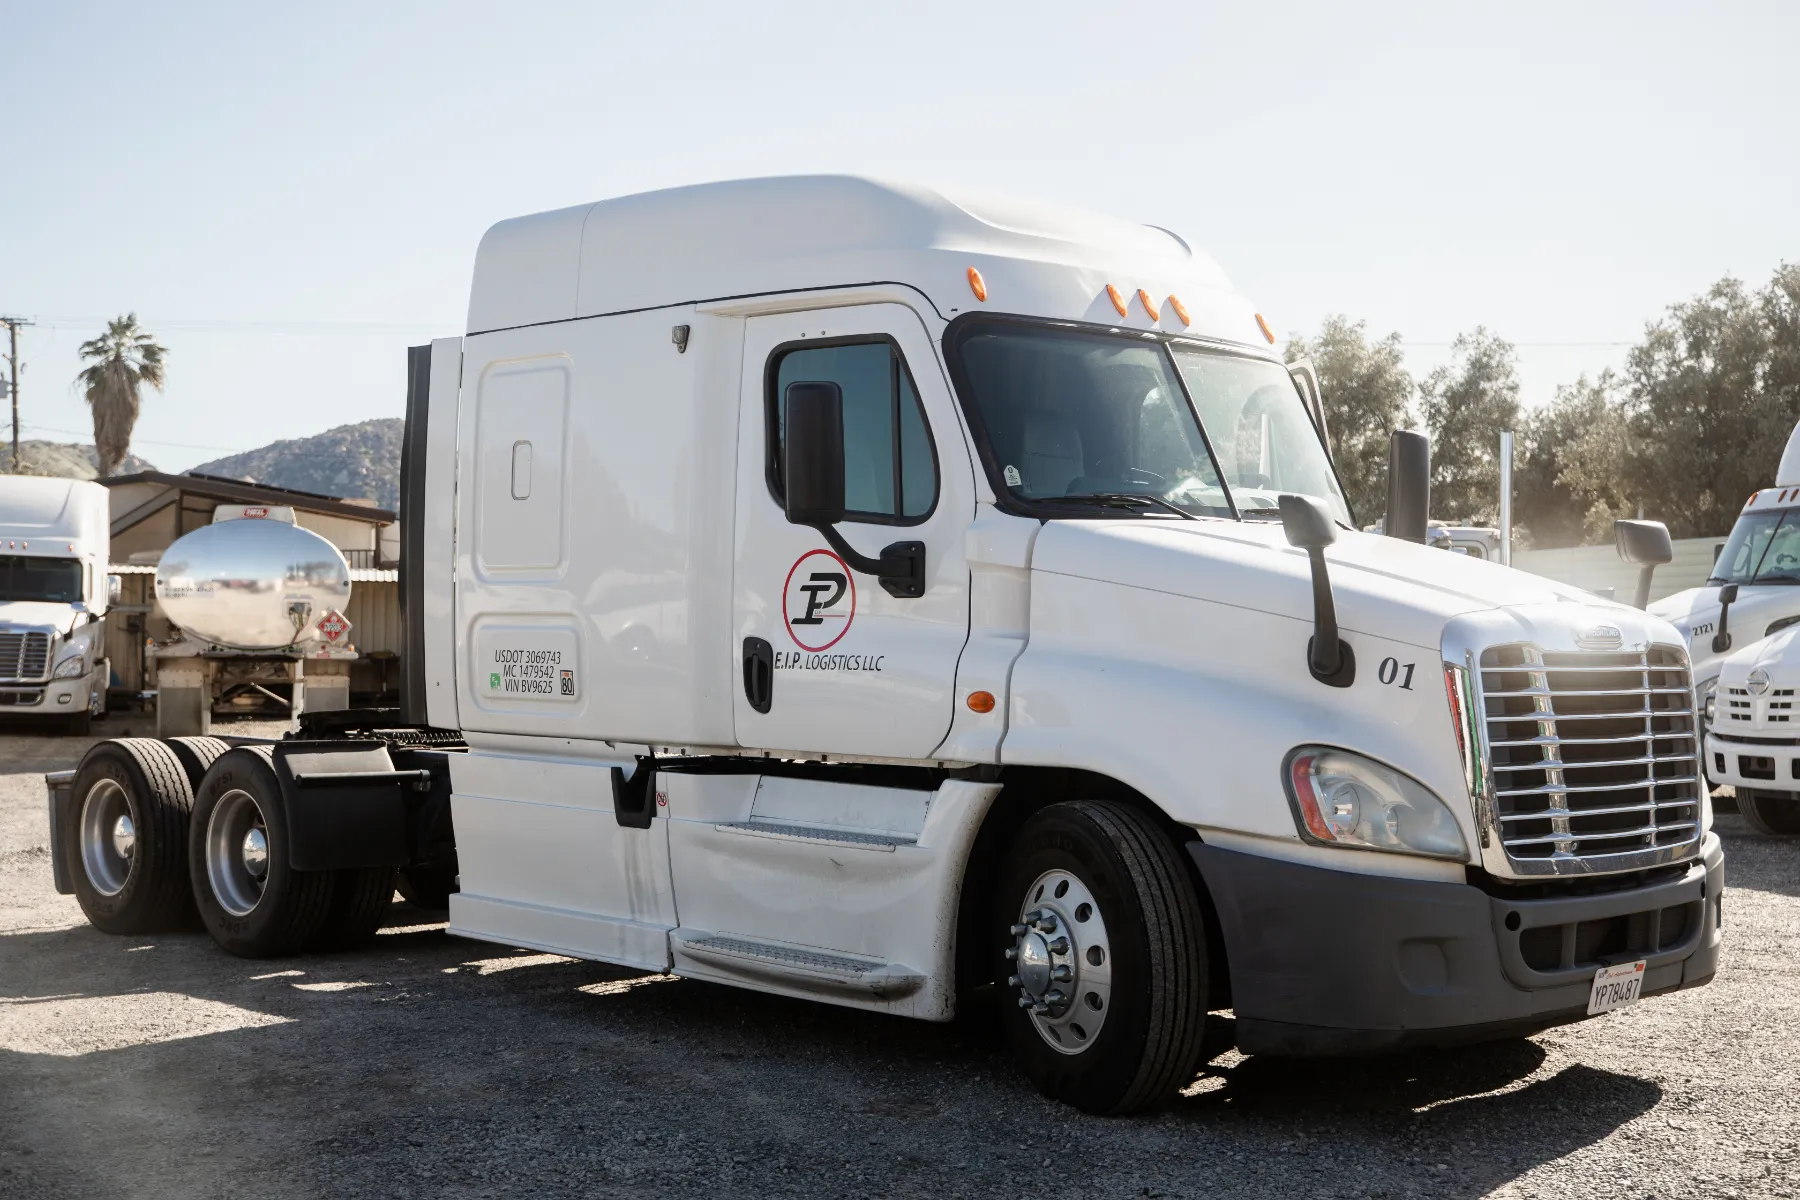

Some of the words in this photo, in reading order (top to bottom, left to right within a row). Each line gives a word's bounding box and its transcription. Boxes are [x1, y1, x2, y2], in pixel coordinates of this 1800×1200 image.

[495, 650, 524, 663] USDOT
[525, 650, 561, 664] 3069743
[774, 652, 803, 670] E.I.P.
[805, 654, 860, 670] LOGISTICS
[862, 655, 885, 671] LLC
[503, 664, 517, 678] MC
[519, 664, 555, 679] 1479542
[1378, 656, 1416, 691] 01
[504, 678, 519, 692] VIN
[521, 679, 553, 694] BV9625
[561, 677, 573, 693] 80
[1594, 979, 1640, 1007] YP78487
